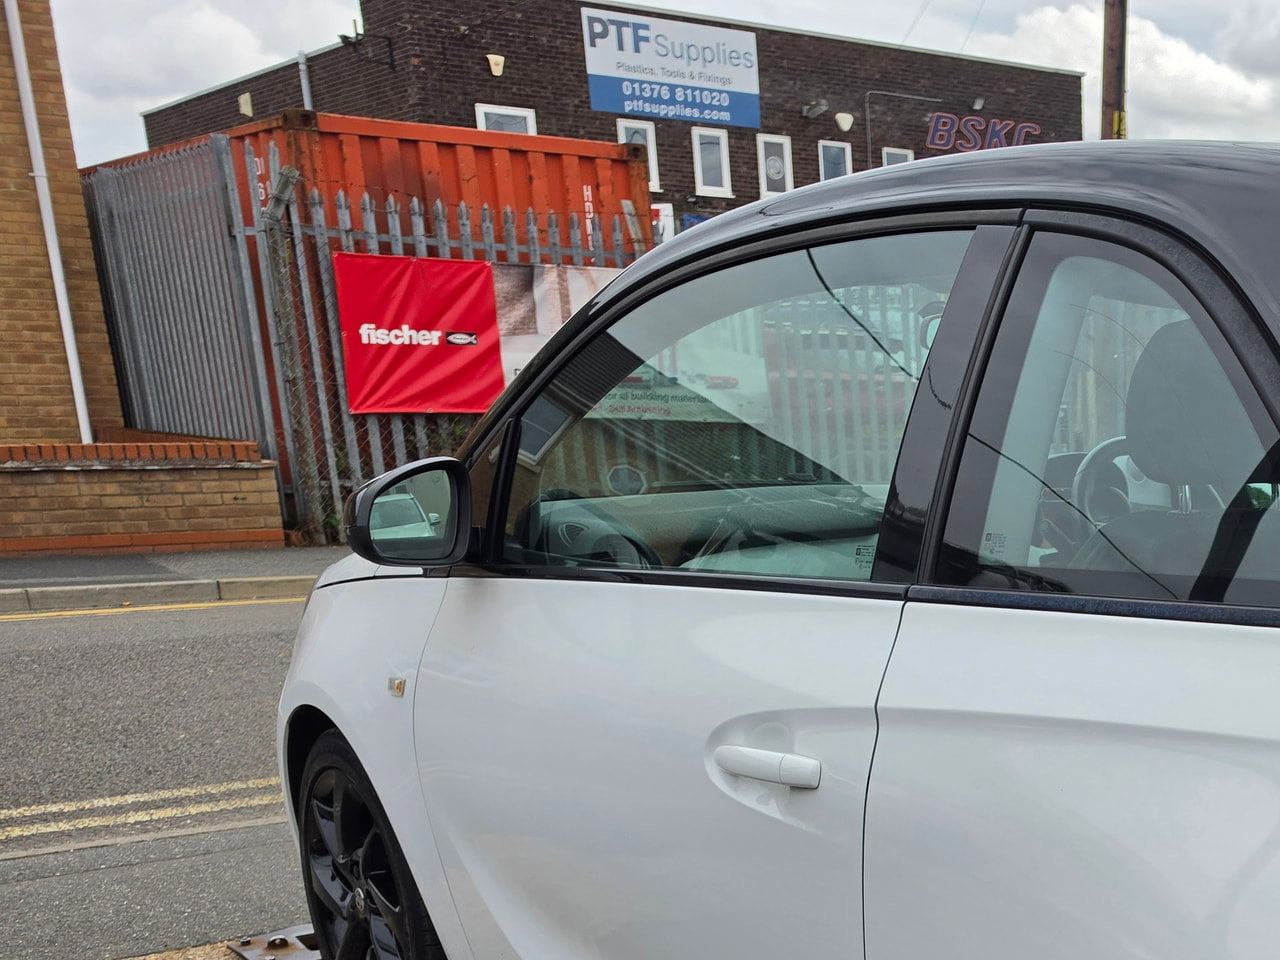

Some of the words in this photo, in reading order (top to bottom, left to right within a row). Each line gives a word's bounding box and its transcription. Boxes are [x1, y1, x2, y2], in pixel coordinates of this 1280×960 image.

[587, 15, 651, 54] PTF
[654, 33, 754, 69] Supplies
[660, 67, 686, 79] Tools
[622, 80, 671, 99] 01376
[675, 87, 730, 106] 811020
[623, 99, 731, 121] ptfsupplies.com
[359, 323, 442, 346] fischer
